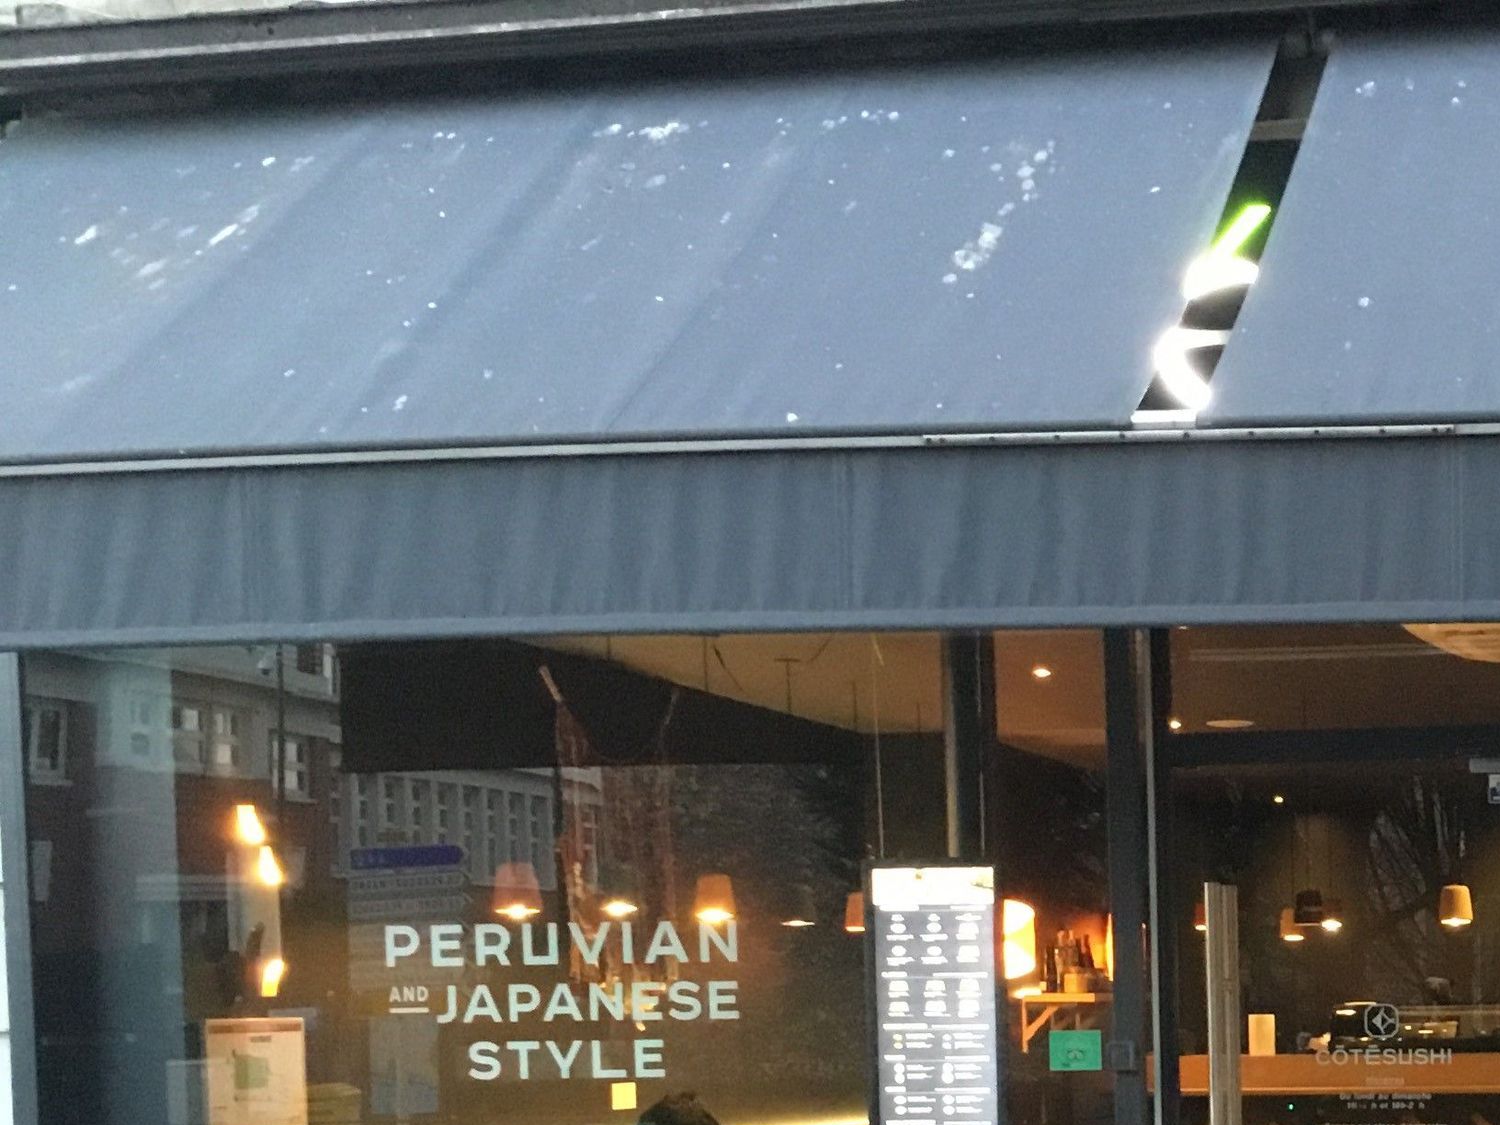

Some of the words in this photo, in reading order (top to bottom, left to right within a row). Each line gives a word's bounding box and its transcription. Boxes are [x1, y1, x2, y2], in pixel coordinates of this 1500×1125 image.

[384, 920, 740, 968] PERUVIAN
[388, 985, 430, 1003] AND
[437, 980, 741, 1024] JAPANESE
[468, 1038, 667, 1081] STYLE
